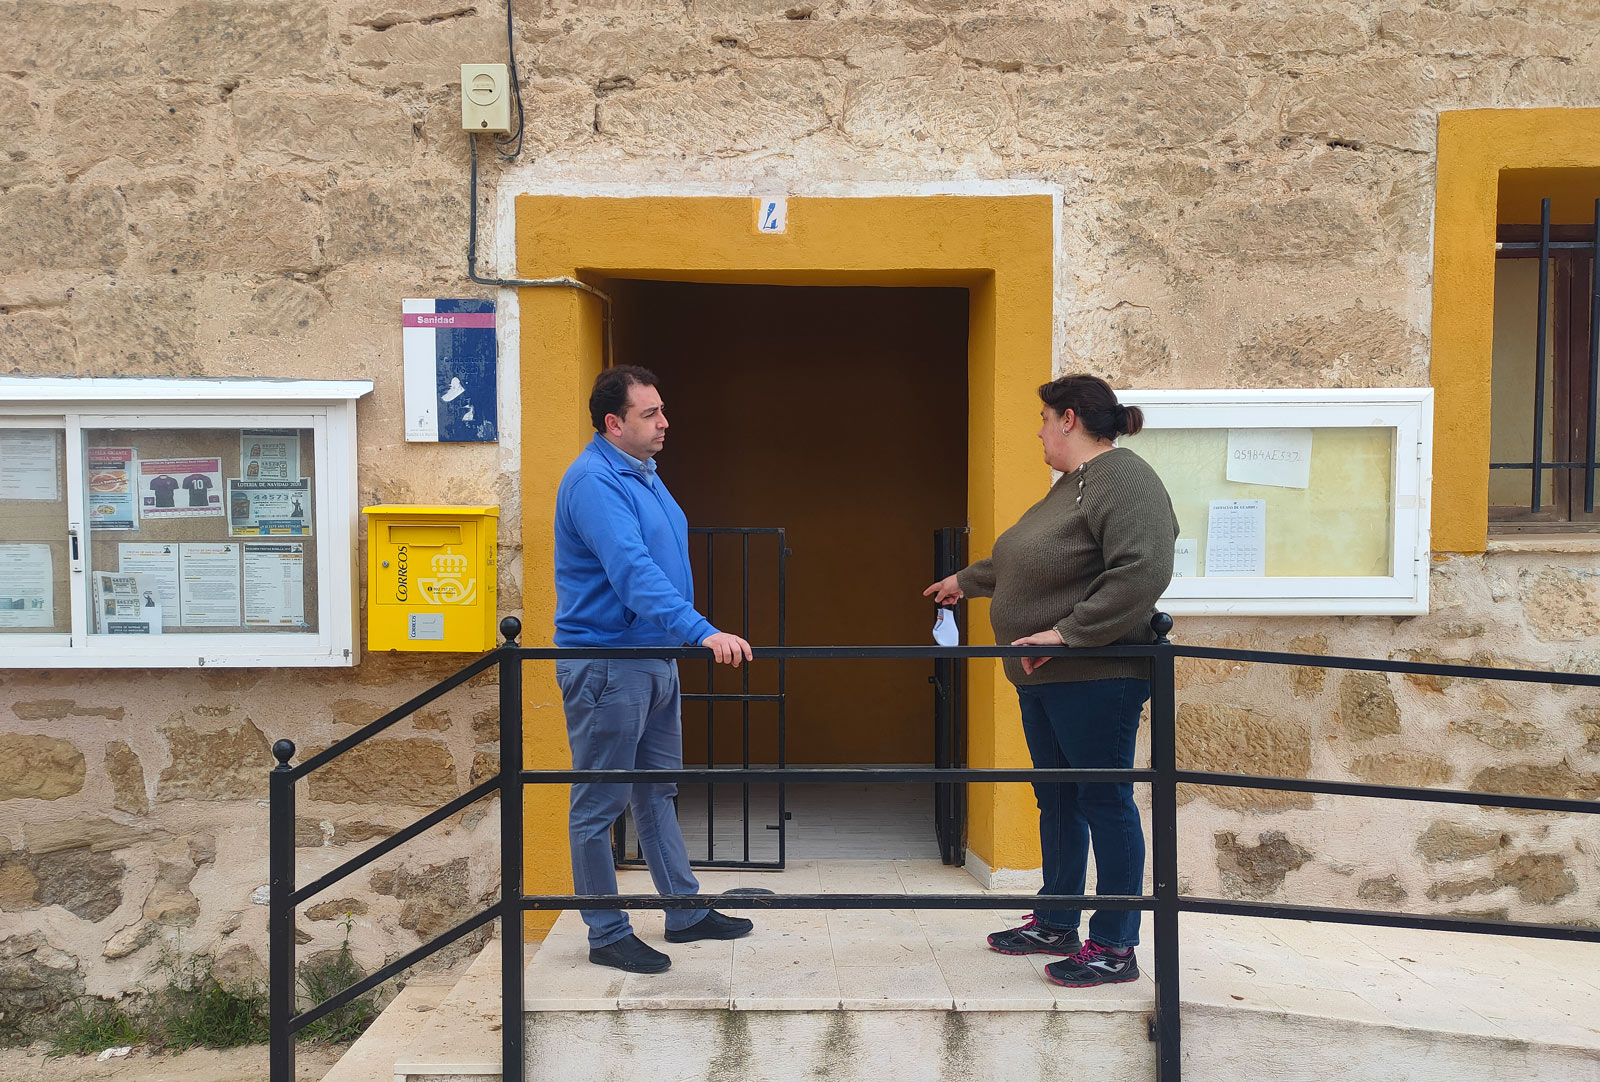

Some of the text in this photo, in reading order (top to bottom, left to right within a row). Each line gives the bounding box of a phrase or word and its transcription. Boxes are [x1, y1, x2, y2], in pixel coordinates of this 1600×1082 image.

[416, 315, 455, 325] Sanidad
[191, 479, 204, 490] 10
[395, 545, 409, 602] CORREOS
